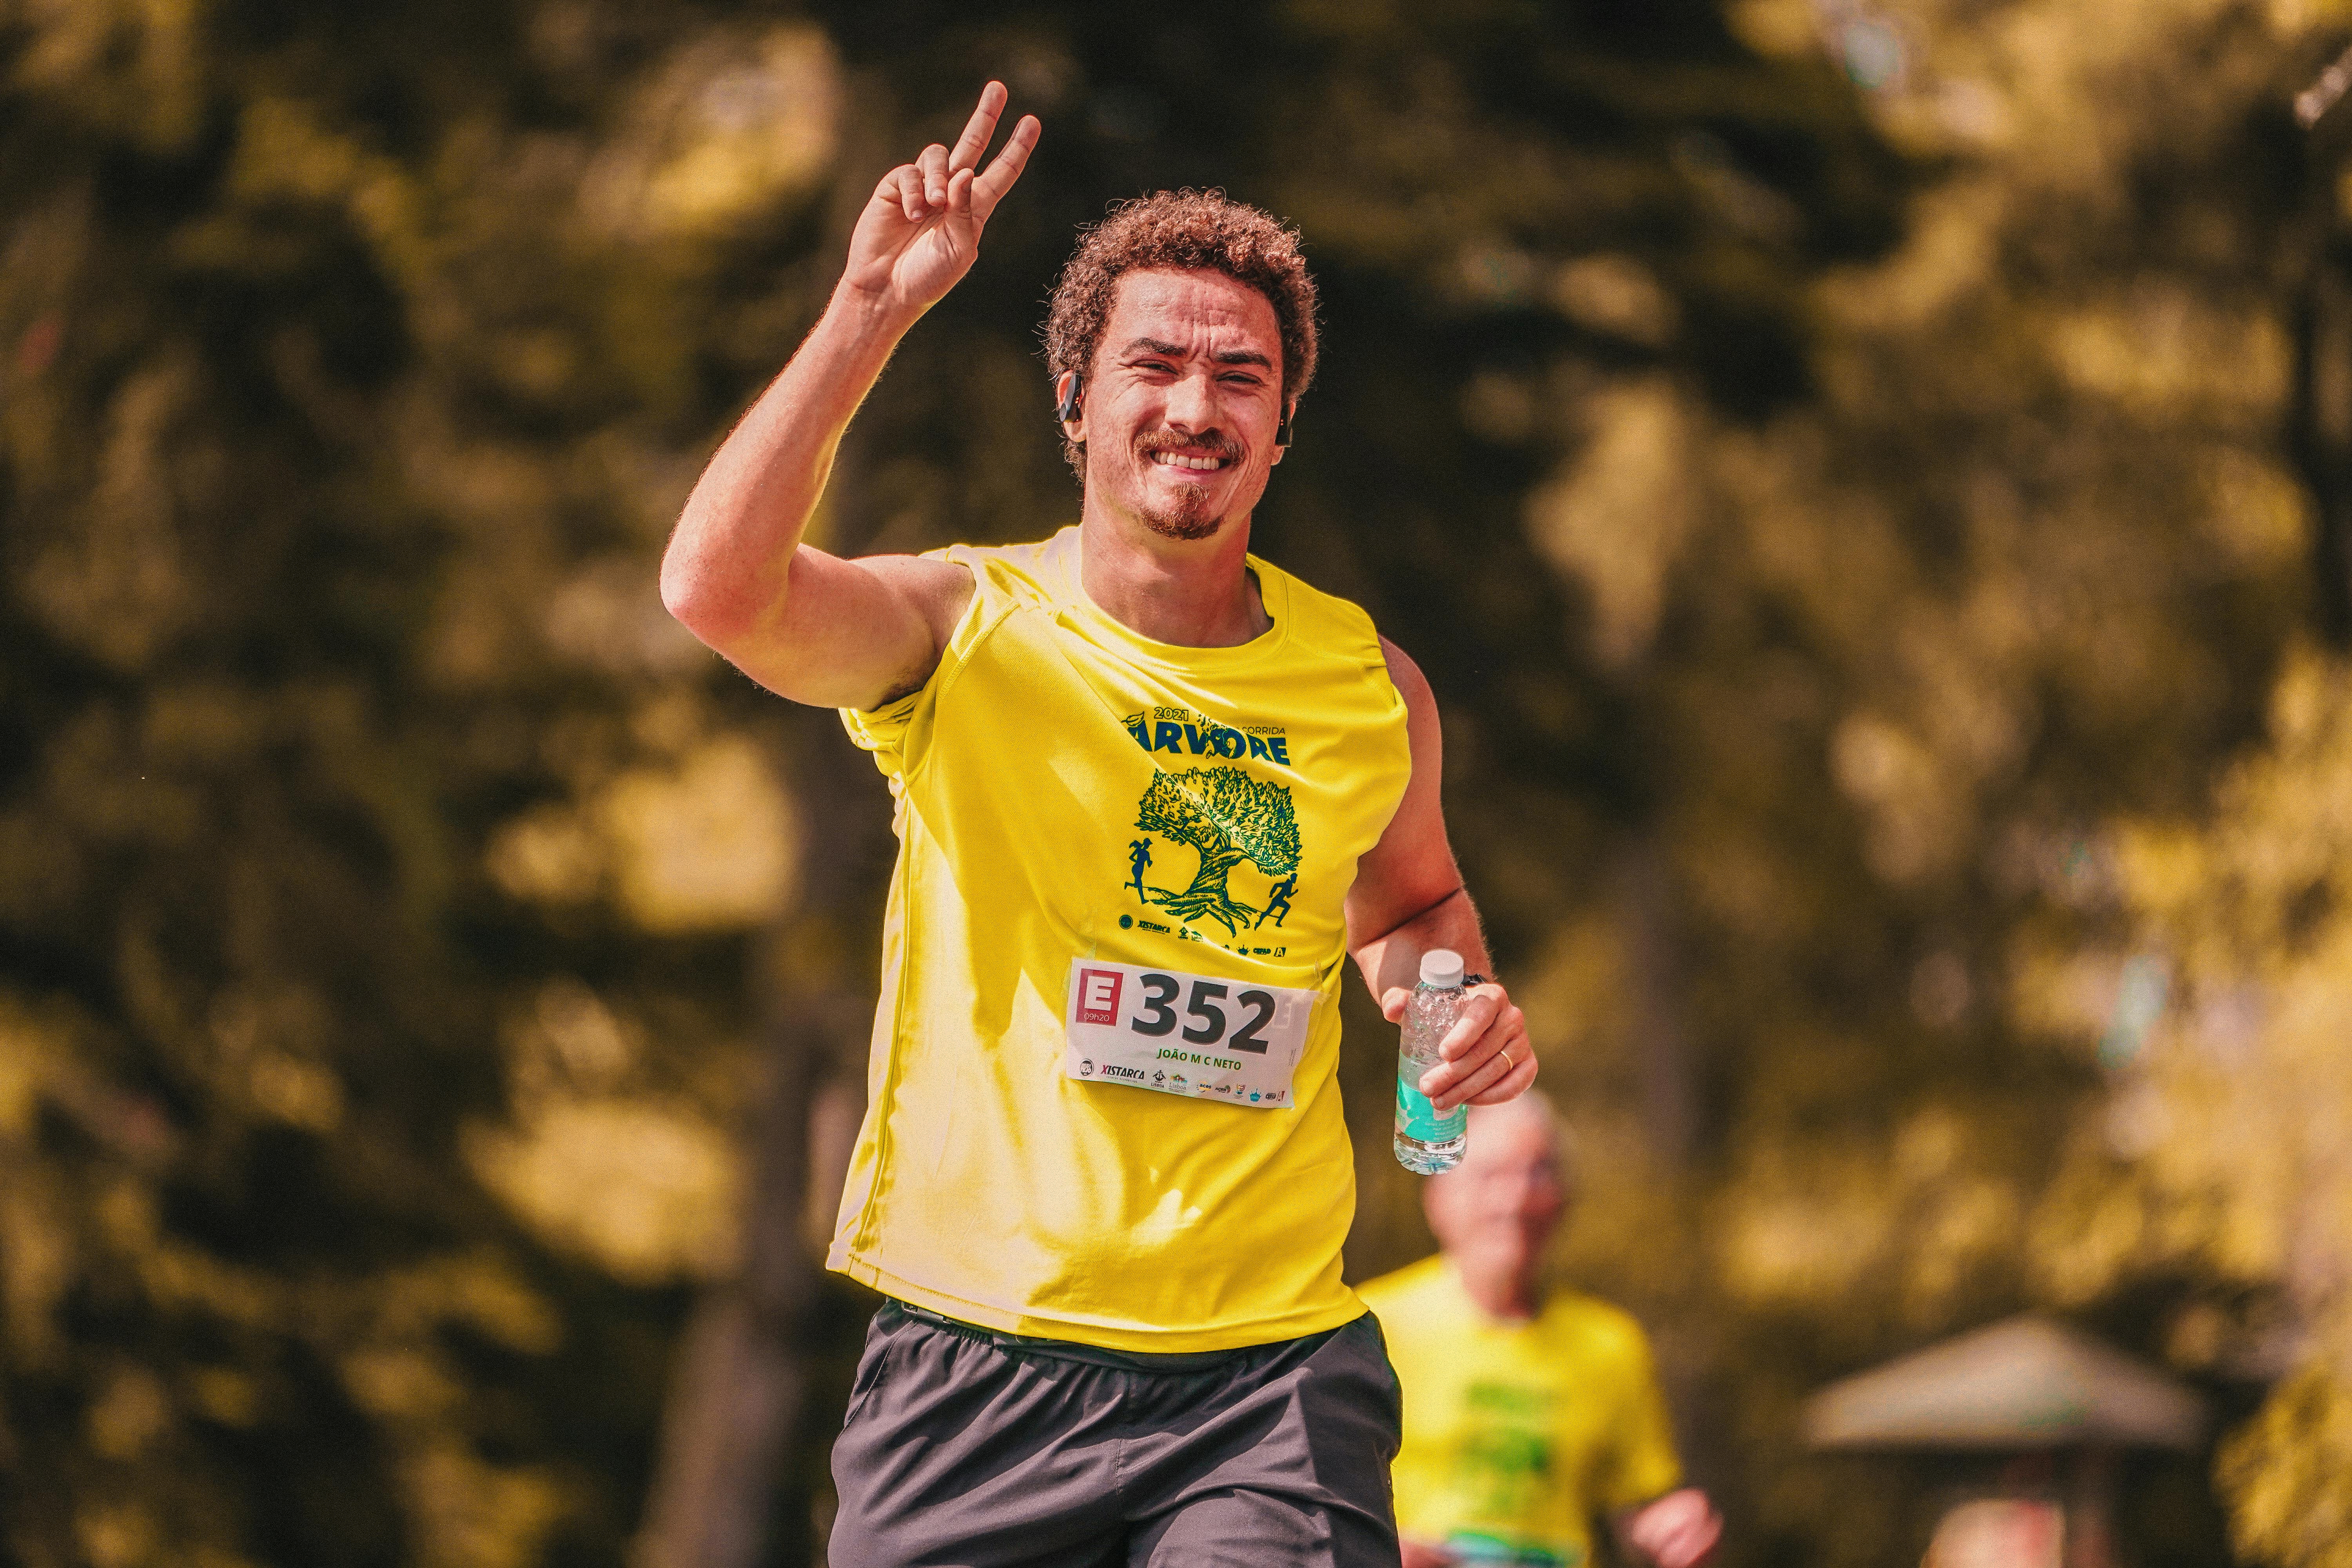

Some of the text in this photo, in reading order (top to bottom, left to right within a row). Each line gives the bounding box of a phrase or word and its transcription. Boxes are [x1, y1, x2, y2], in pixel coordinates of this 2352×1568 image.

[1154, 707, 1189, 721] 2021
[1084, 976, 1114, 1011] E
[1084, 1013, 1109, 1022] 09h20
[1131, 973, 1276, 1054] 352
[1156, 1049, 1241, 1070] JOÃO M C NETO
[1101, 1065, 1145, 1080] XISTARCA
